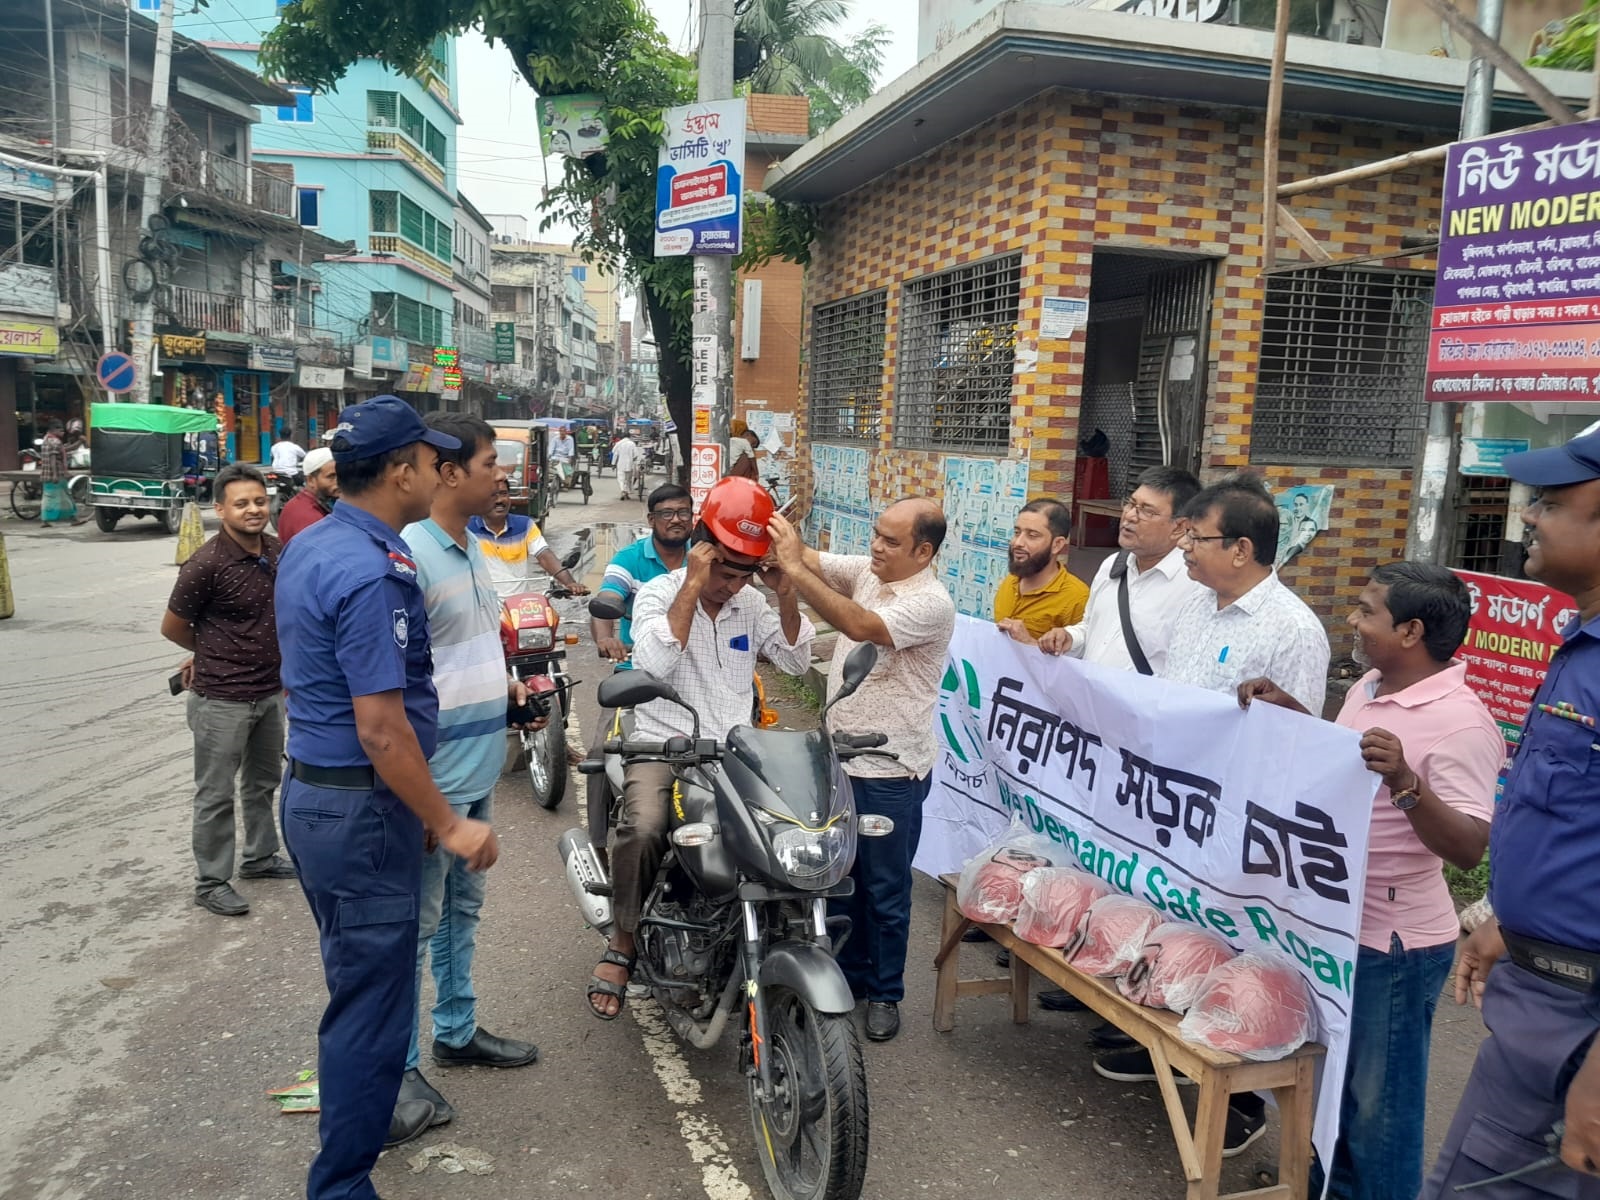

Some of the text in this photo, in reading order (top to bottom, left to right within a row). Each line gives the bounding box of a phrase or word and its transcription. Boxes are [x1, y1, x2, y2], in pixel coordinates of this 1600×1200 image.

[681, 111, 720, 134] উদ্ভাস
[670, 137, 709, 161] ভার্সিটি
[1457, 142, 1524, 197] নিউ
[1449, 204, 1504, 237] NEW
[1486, 594, 1551, 631] মডার্ণ
[1475, 630, 1544, 662] MODERN
[945, 752, 988, 788] নিসচা
[987, 677, 1350, 904] নিরাপদ সড়ক চাই
[1024, 795, 1138, 894] Demand
[1143, 867, 1239, 938] Safe
[1552, 960, 1587, 980] POLICE
